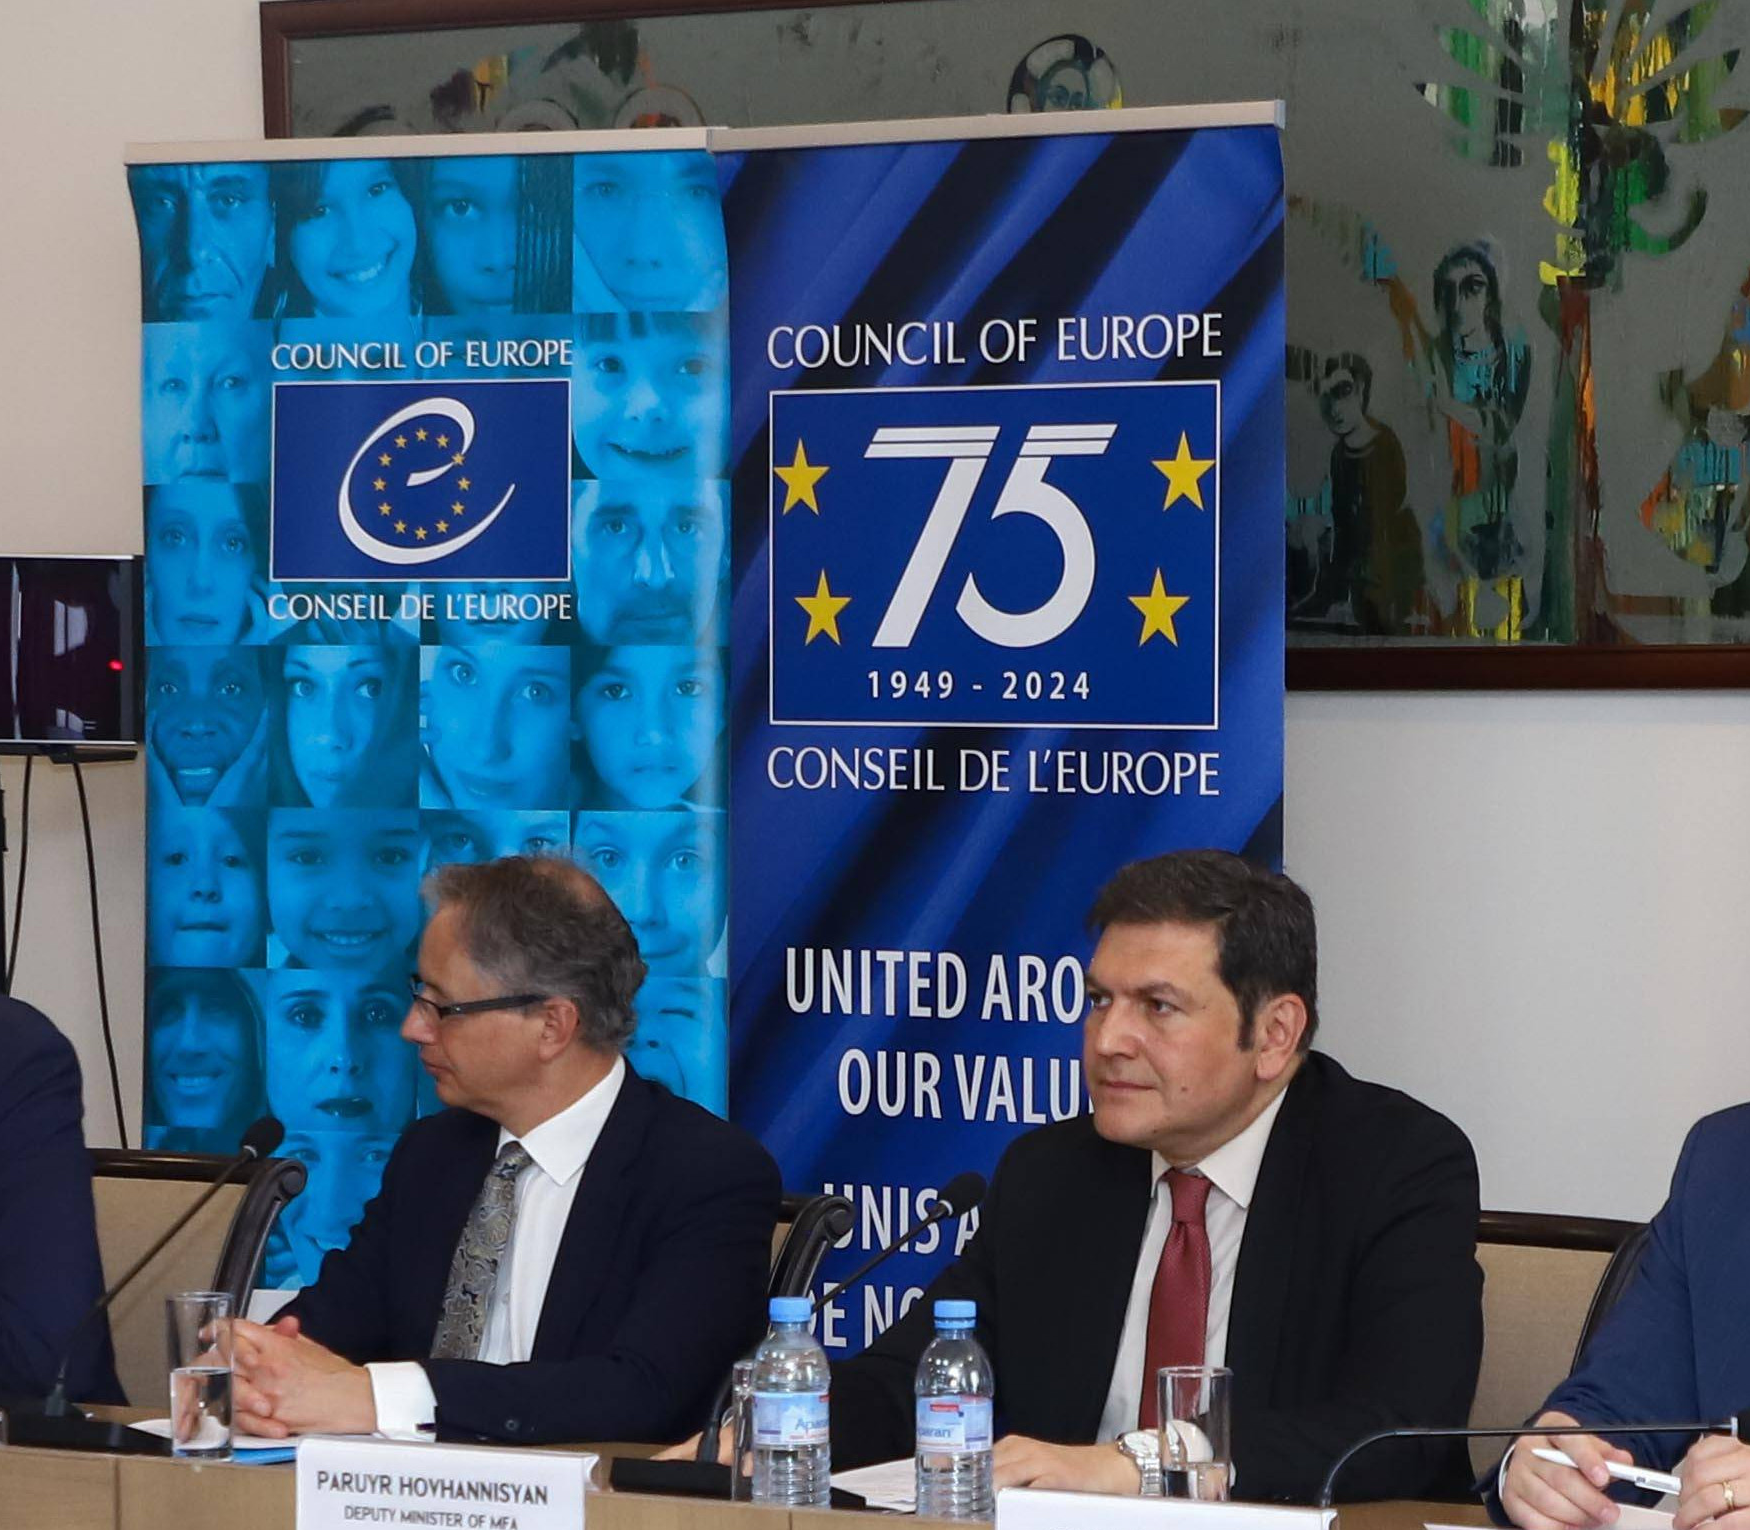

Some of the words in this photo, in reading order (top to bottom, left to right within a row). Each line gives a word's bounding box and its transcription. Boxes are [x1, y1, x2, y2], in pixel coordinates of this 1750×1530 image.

[270, 342, 407, 371] COUNCIL
[414, 341, 453, 368] OF
[465, 339, 574, 368] EUROPE
[767, 321, 966, 370] COUNCIL
[978, 318, 1037, 364] OF
[1057, 312, 1223, 361] EUROPE
[863, 423, 1118, 648] 75
[267, 593, 391, 621] CONSEIL
[400, 594, 436, 621] DE
[446, 592, 572, 621] L'EUROPE
[867, 669, 955, 701] 1949
[1001, 670, 1091, 701] 2024
[767, 745, 945, 792] CONSEIL
[958, 748, 1011, 793] DE
[1027, 748, 1220, 797] L'EUROPE
[785, 946, 968, 1020] UNITED
[837, 1047, 943, 1120] OUR
[954, 1053, 1095, 1125] VALU
[316, 1470, 394, 1496] PARUYR
[398, 1476, 549, 1507] HOVHANNISYAN
[343, 1505, 396, 1524] DEPUTY
[399, 1509, 463, 1528] MINISTER
[467, 1514, 486, 1530] OF
